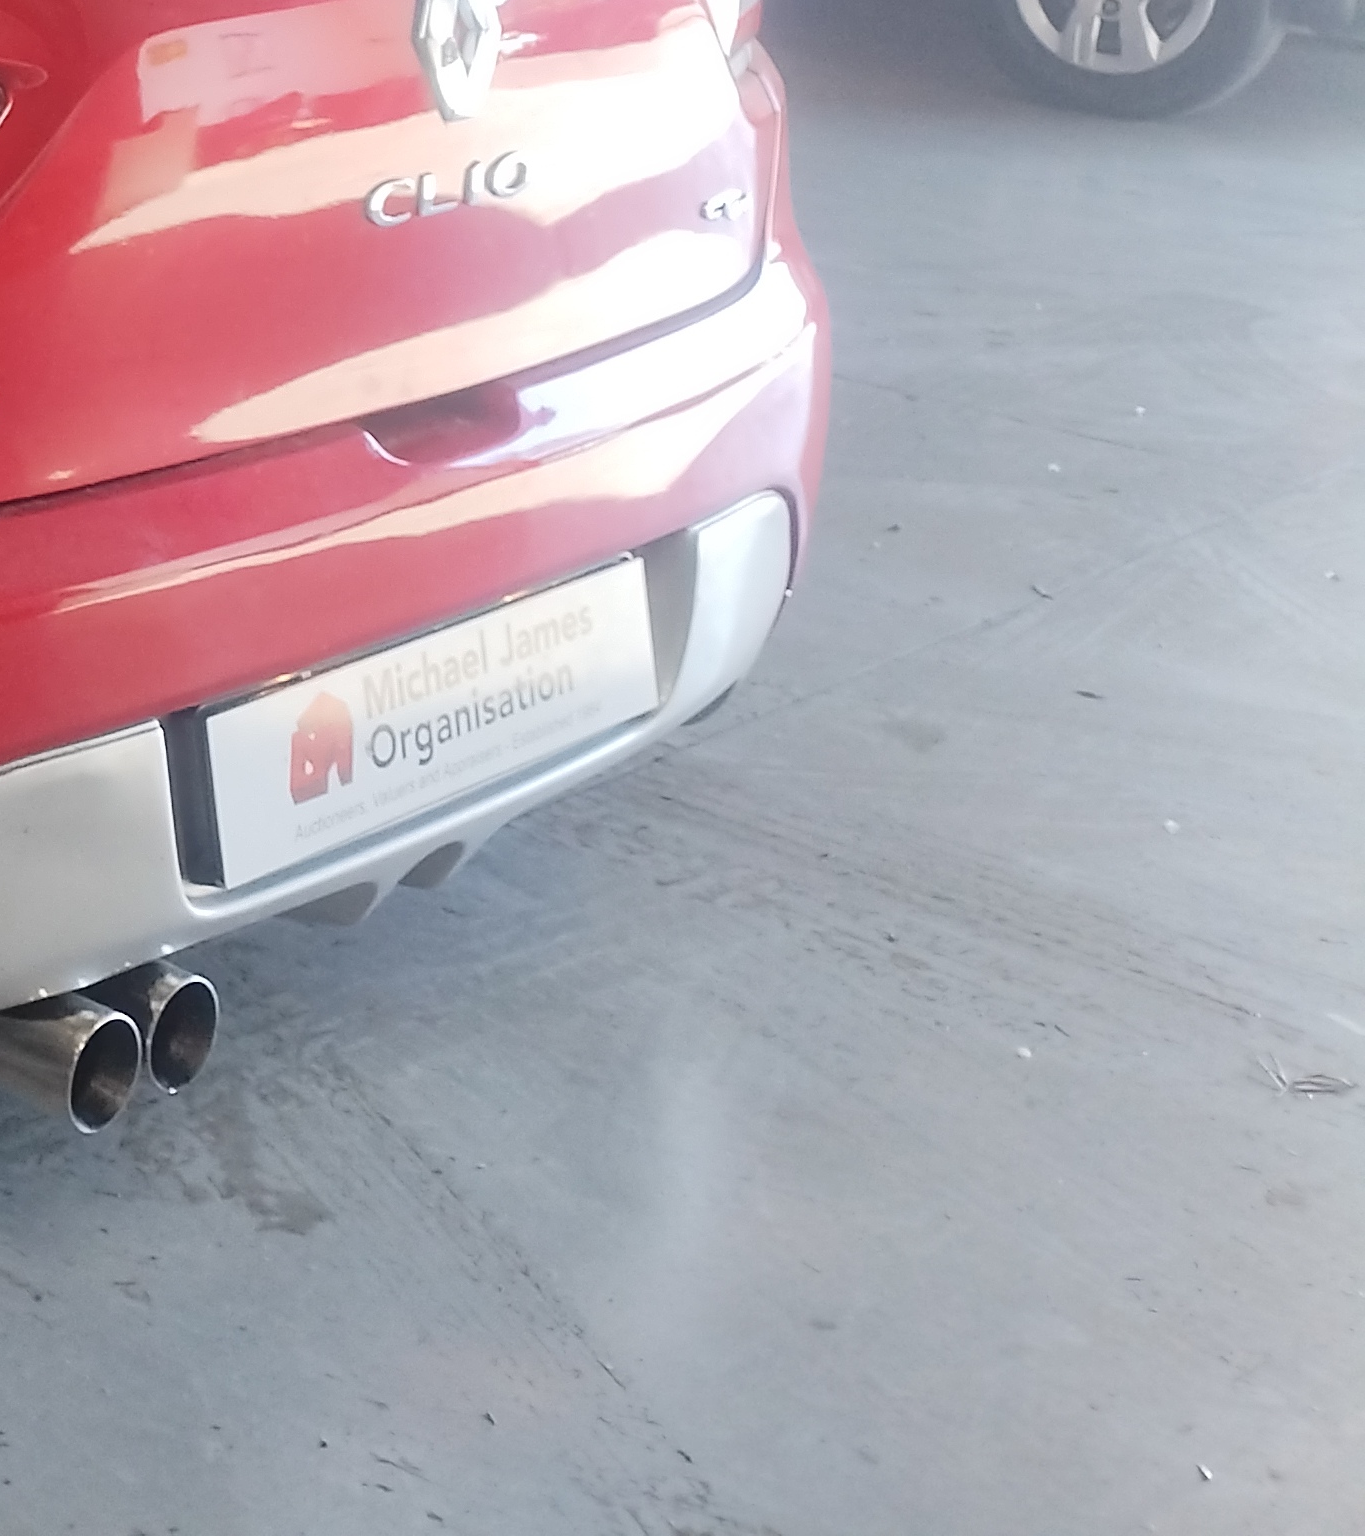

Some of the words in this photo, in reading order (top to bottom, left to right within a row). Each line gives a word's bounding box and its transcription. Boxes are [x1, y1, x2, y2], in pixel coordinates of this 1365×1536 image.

[365, 150, 529, 228] CLIO
[362, 628, 488, 719] Michael
[500, 605, 593, 663] James
[371, 664, 575, 768] Organisation
